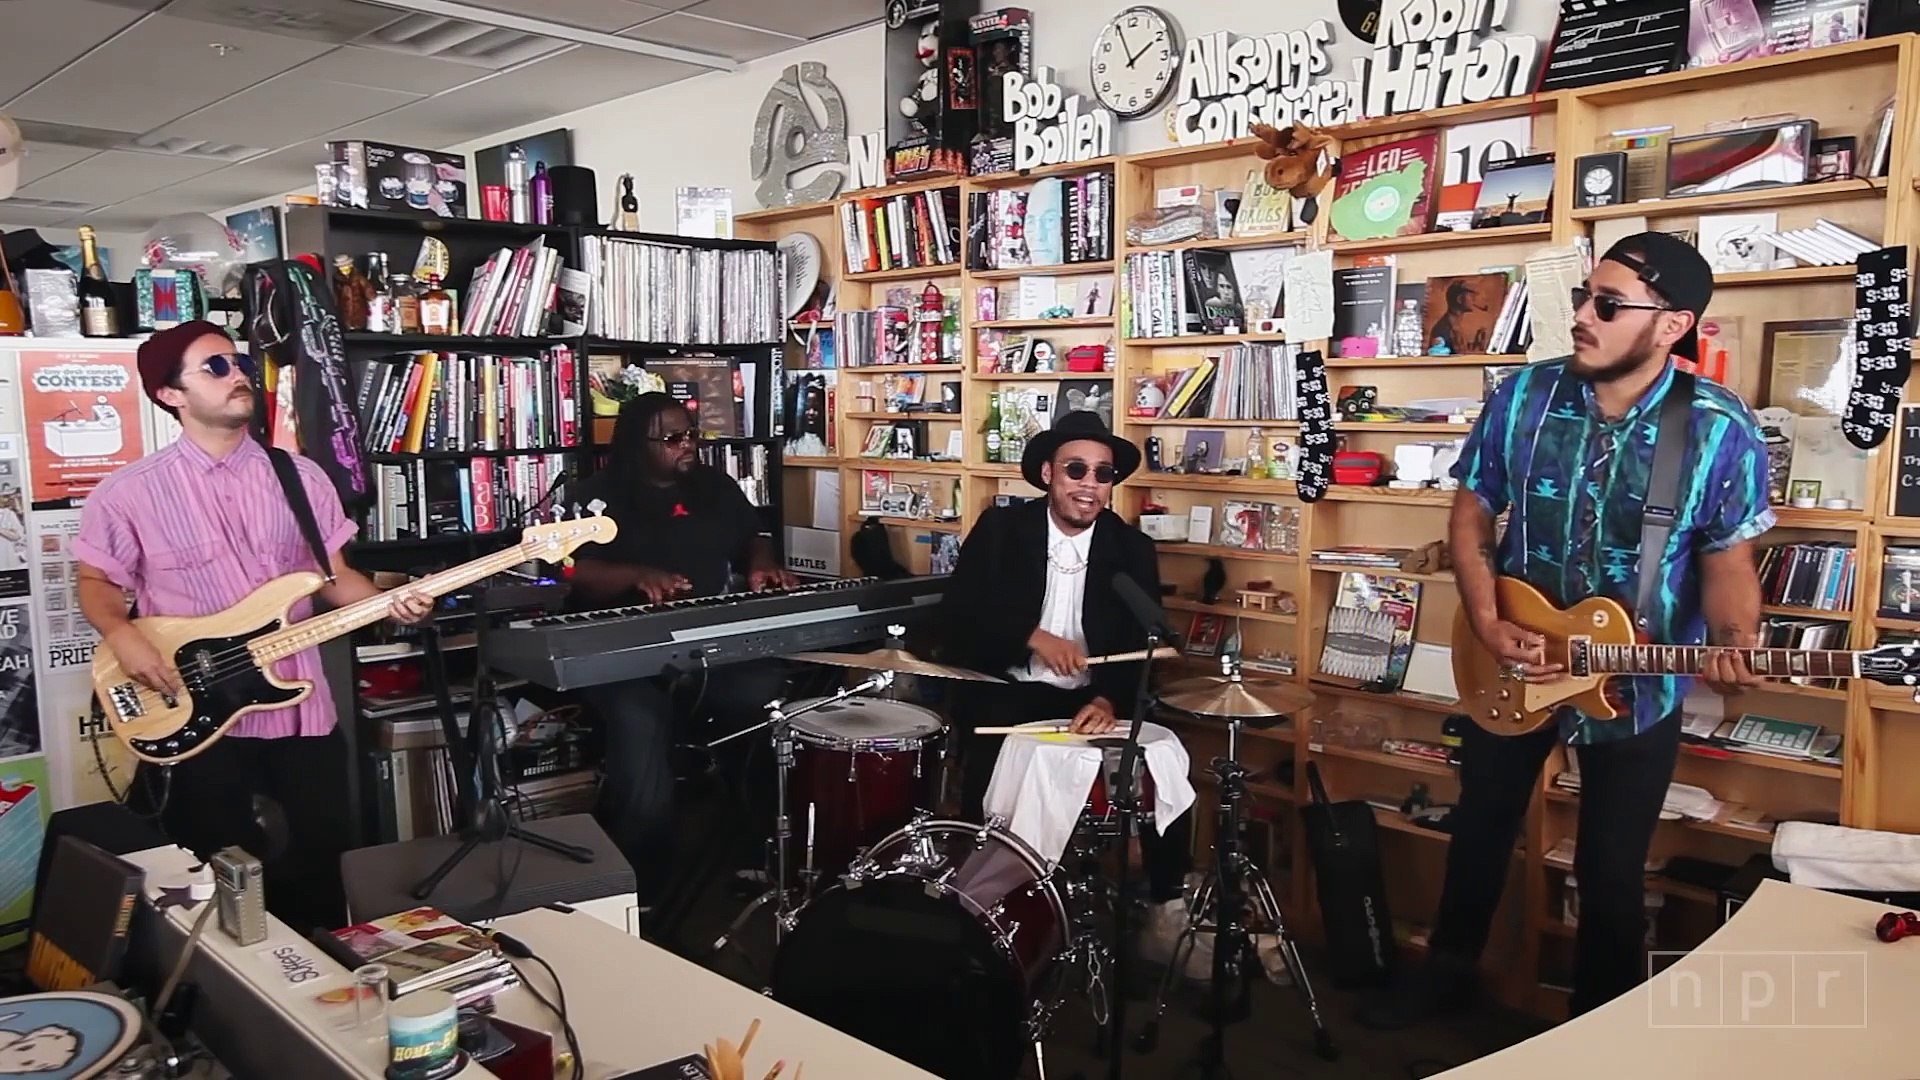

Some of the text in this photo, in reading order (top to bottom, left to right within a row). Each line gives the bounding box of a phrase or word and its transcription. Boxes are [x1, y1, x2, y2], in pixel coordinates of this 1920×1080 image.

[1128, 17, 1138, 28] 12
[1155, 31, 1164, 42] 2
[1102, 42, 1112, 53] 10
[1160, 49, 1169, 62] 3
[1097, 63, 1106, 74] 9
[1155, 71, 1164, 81] 4
[1366, 33, 1537, 119] Hilton
[1002, 65, 1062, 122] Bob
[1102, 81, 1111, 92] 8
[1144, 87, 1153, 99] 5
[1113, 94, 1122, 105] 7
[1128, 96, 1137, 107] 6
[1015, 94, 1111, 171] Boilen
[1366, 148, 1402, 176] LED
[1450, 139, 1517, 184] 10
[1239, 207, 1283, 225] DRUGS
[1866, 285, 1900, 303] 9:30
[1863, 321, 1898, 338] 9:30
[1860, 355, 1897, 371] 9:30
[37, 375, 125, 388] CONTEST
[1851, 391, 1885, 410] 9:30
[788, 556, 827, 570] BEATLES
[393, 1044, 433, 1062] HOME
